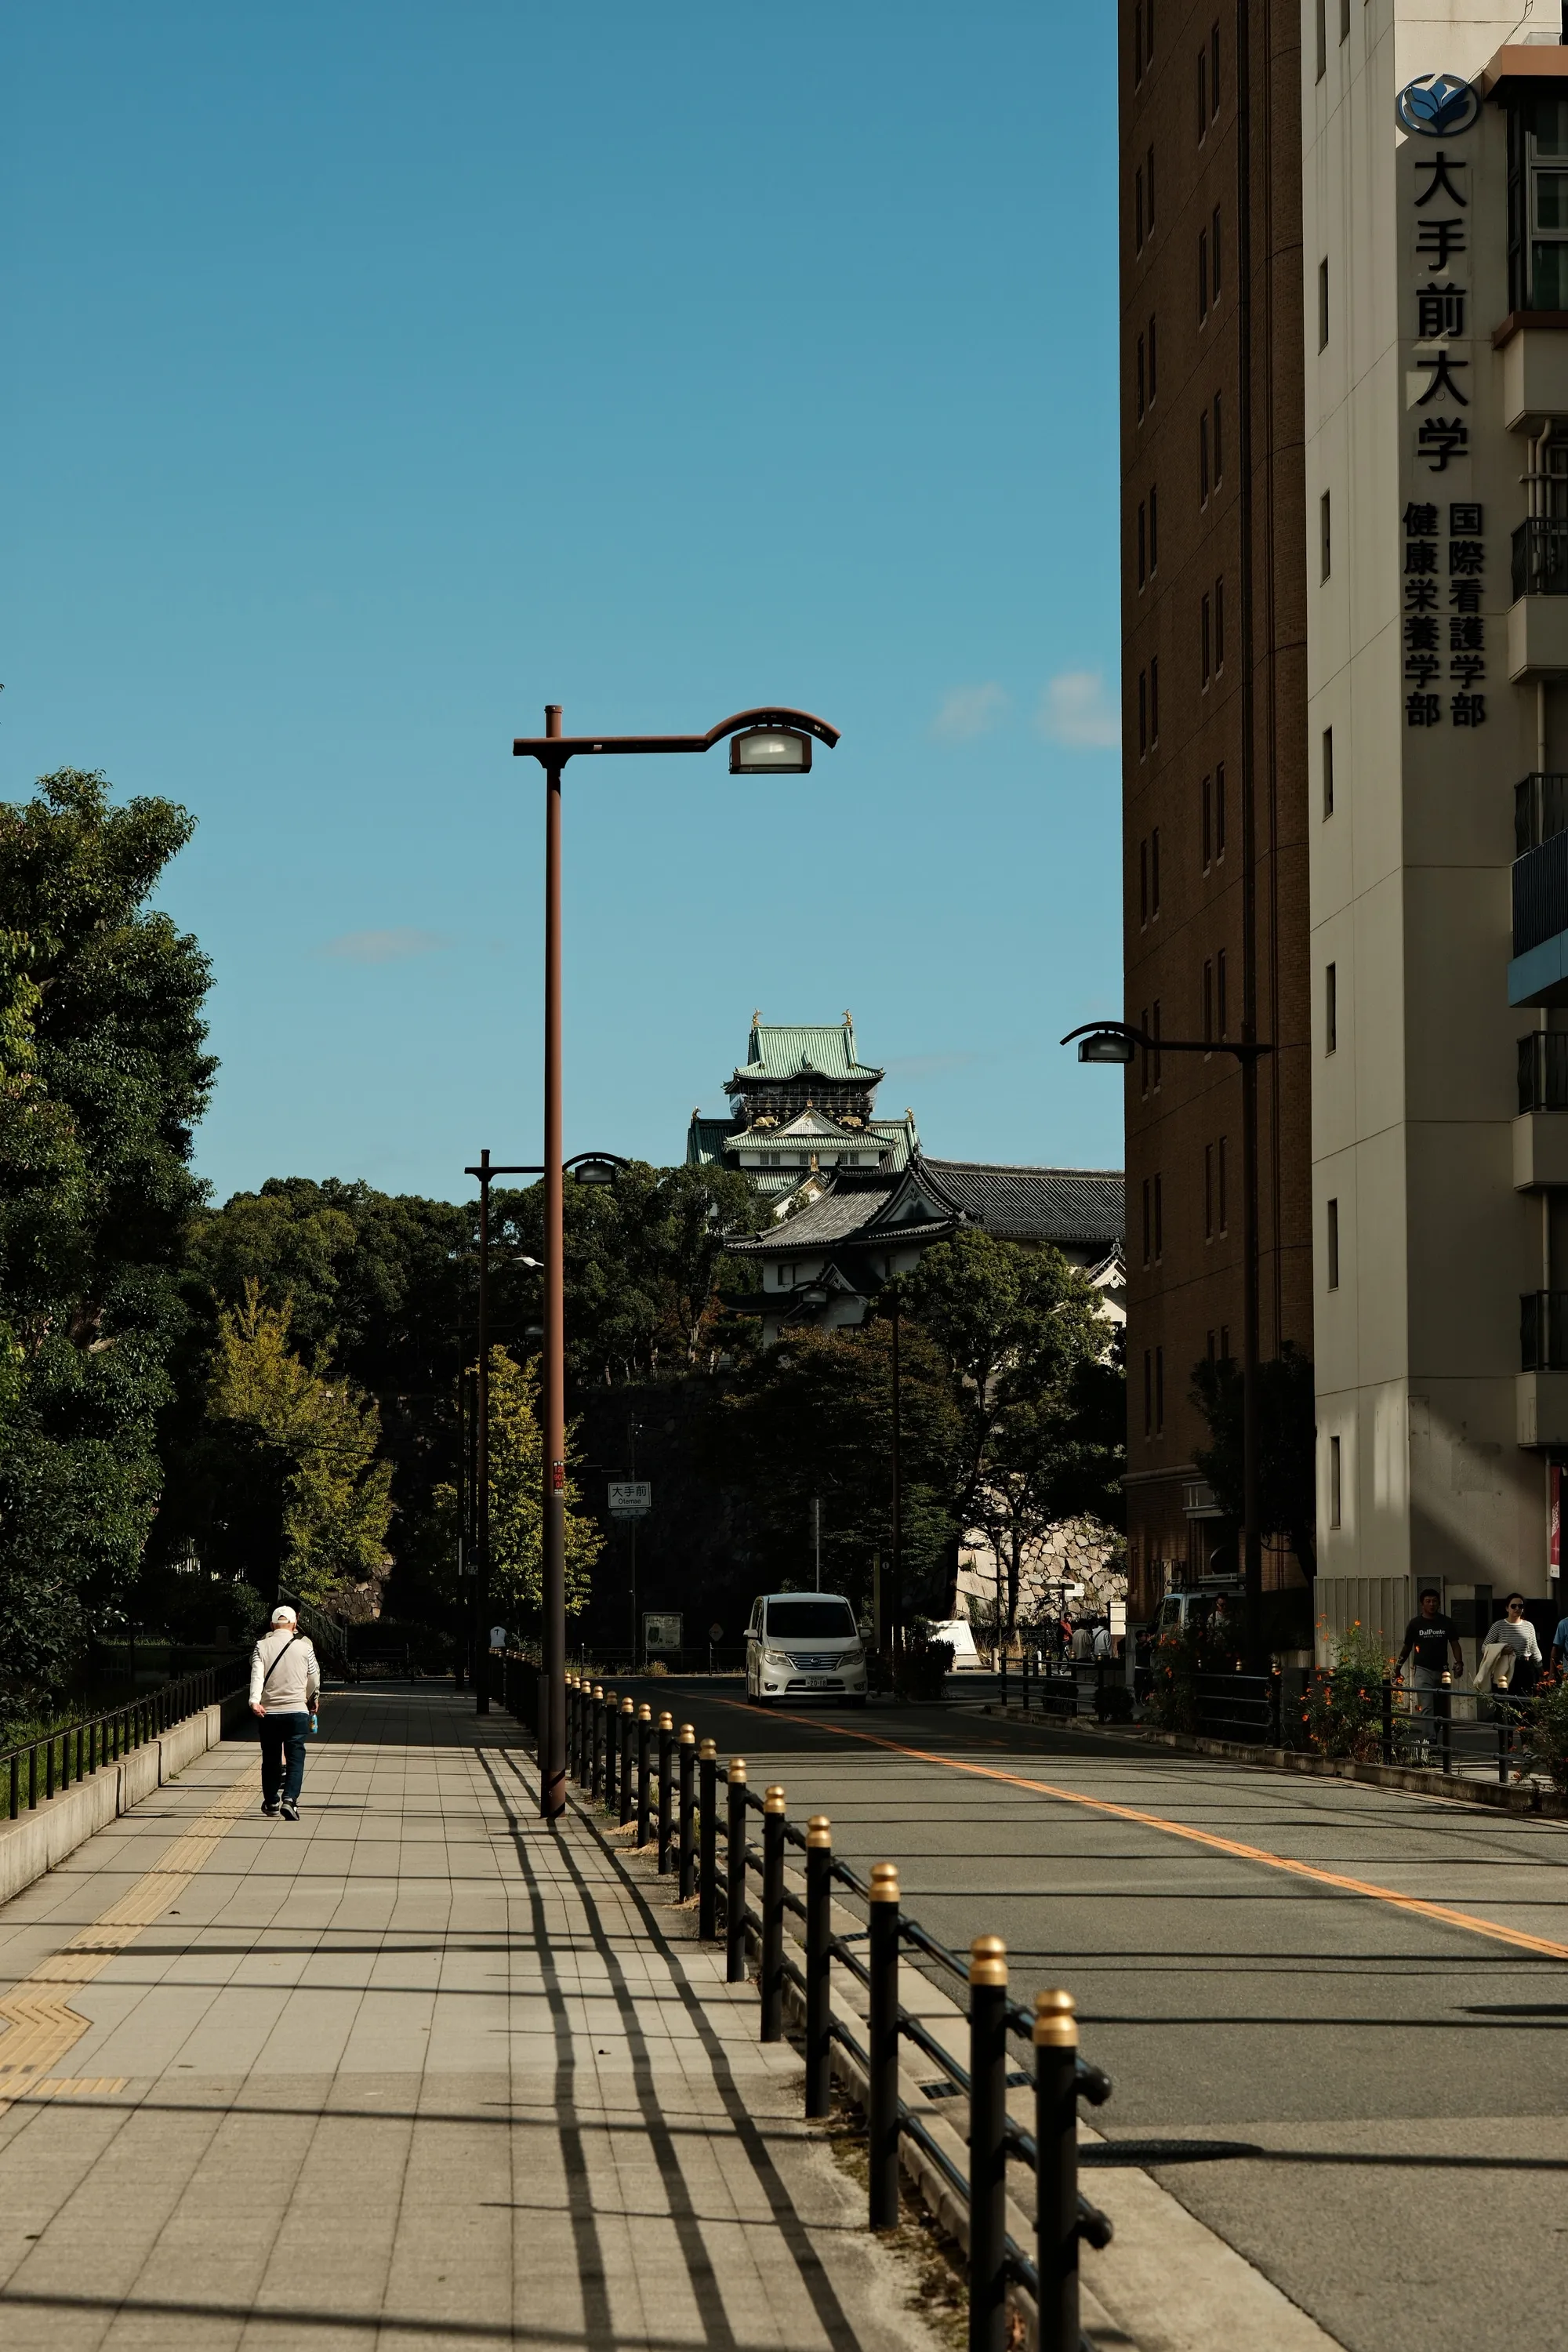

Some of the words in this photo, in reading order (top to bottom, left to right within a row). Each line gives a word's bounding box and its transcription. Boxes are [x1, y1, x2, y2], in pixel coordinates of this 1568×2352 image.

[1414, 151, 1468, 473] 大手前大学
[1403, 502, 1440, 728] 健康栄養学部
[1449, 503, 1486, 728] 国際看護学部
[612, 1486, 647, 1497] 大手前
